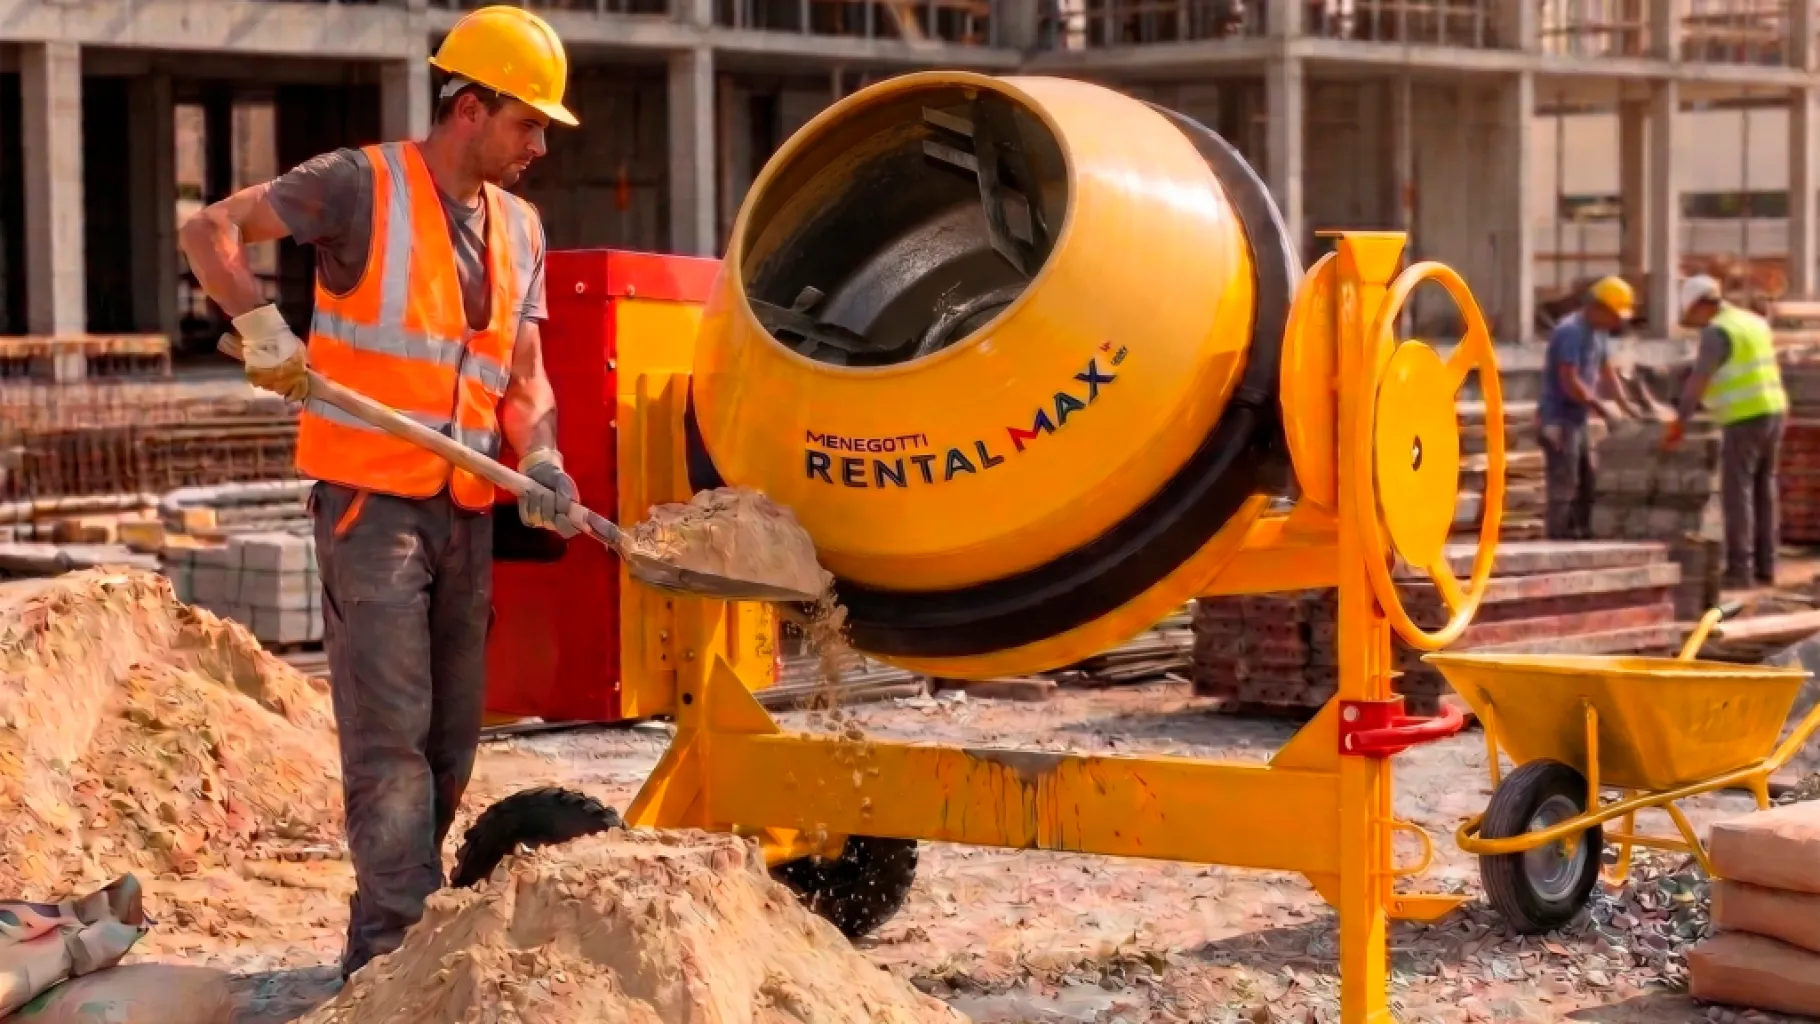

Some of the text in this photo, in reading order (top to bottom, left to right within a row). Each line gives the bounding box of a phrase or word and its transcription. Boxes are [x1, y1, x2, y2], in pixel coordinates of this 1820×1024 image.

[805, 357, 1117, 489] RENTAL MAX
[806, 430, 928, 452] MENEGOTTI
